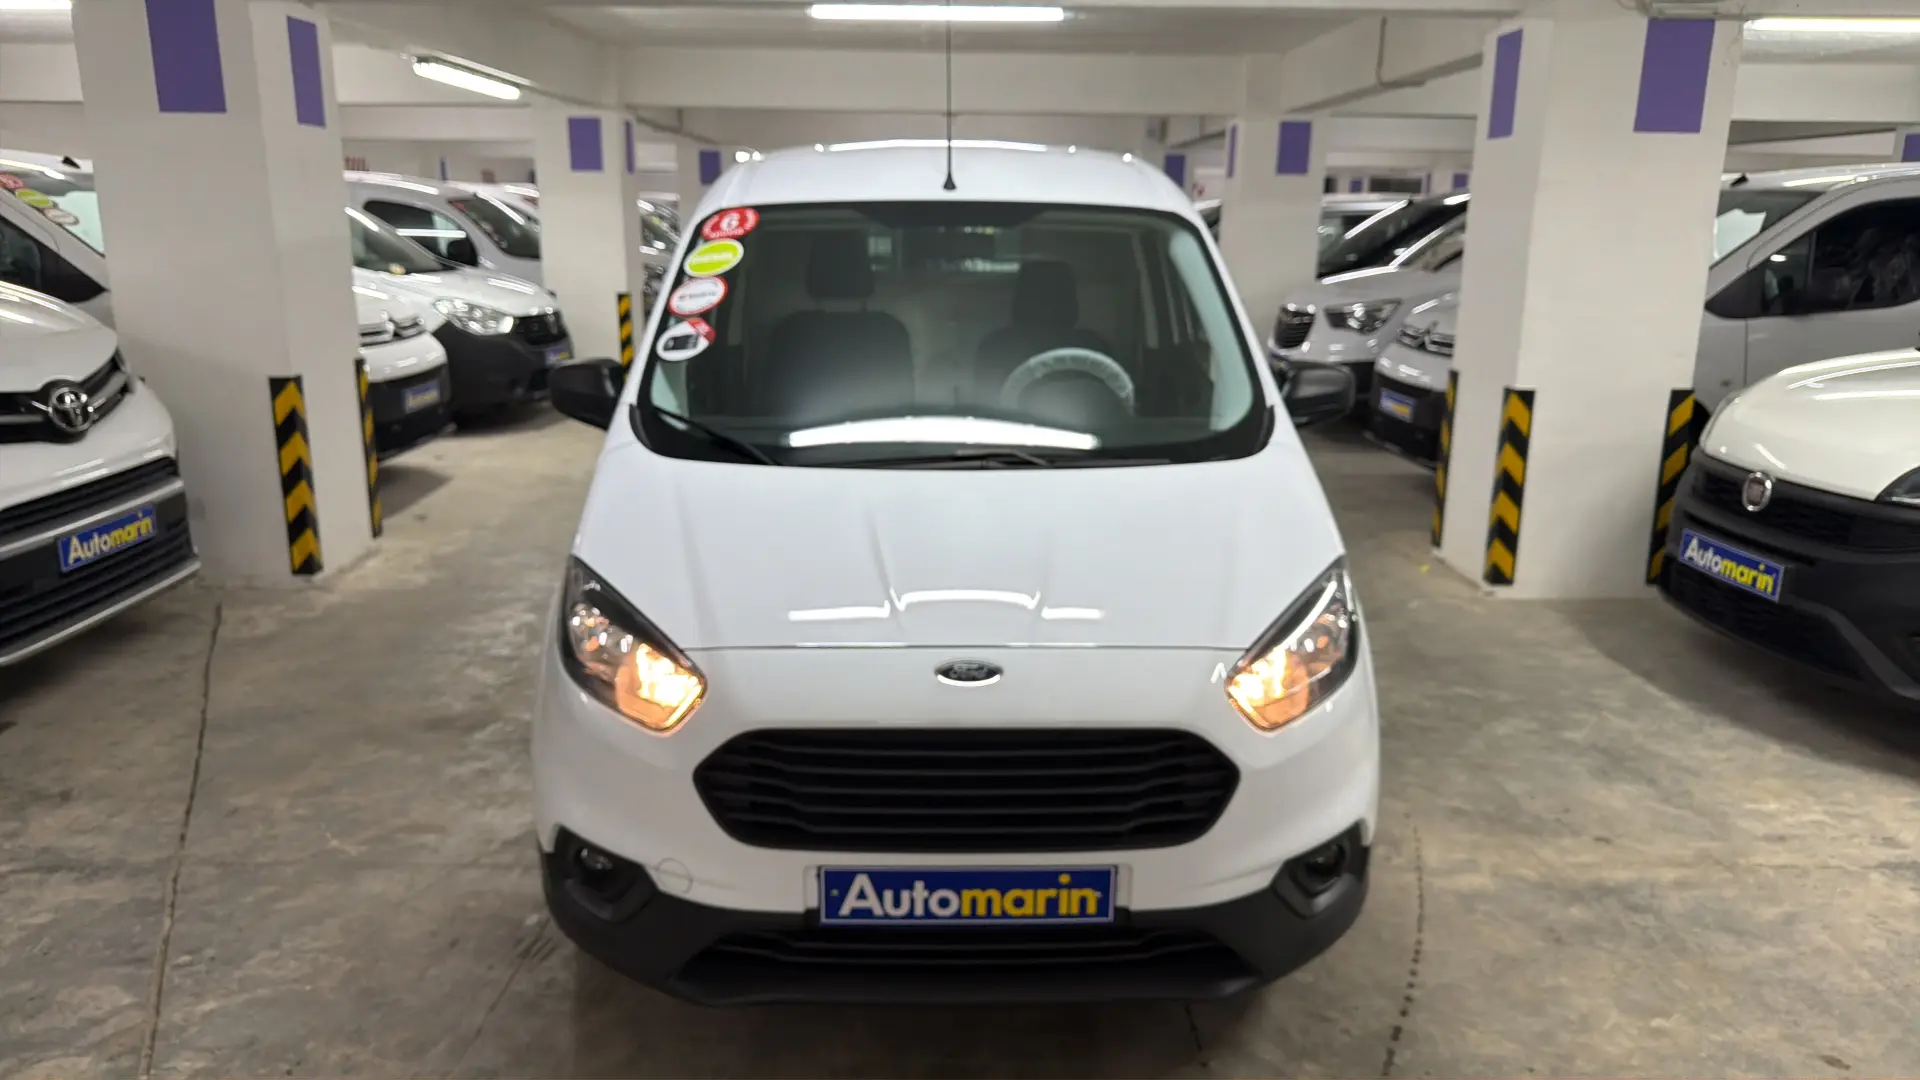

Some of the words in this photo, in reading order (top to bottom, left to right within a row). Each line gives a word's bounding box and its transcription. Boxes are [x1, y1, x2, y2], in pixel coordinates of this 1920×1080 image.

[68, 512, 153, 565] Automarin
[1684, 537, 1774, 593] Automarin
[838, 872, 1098, 918] Automarin
